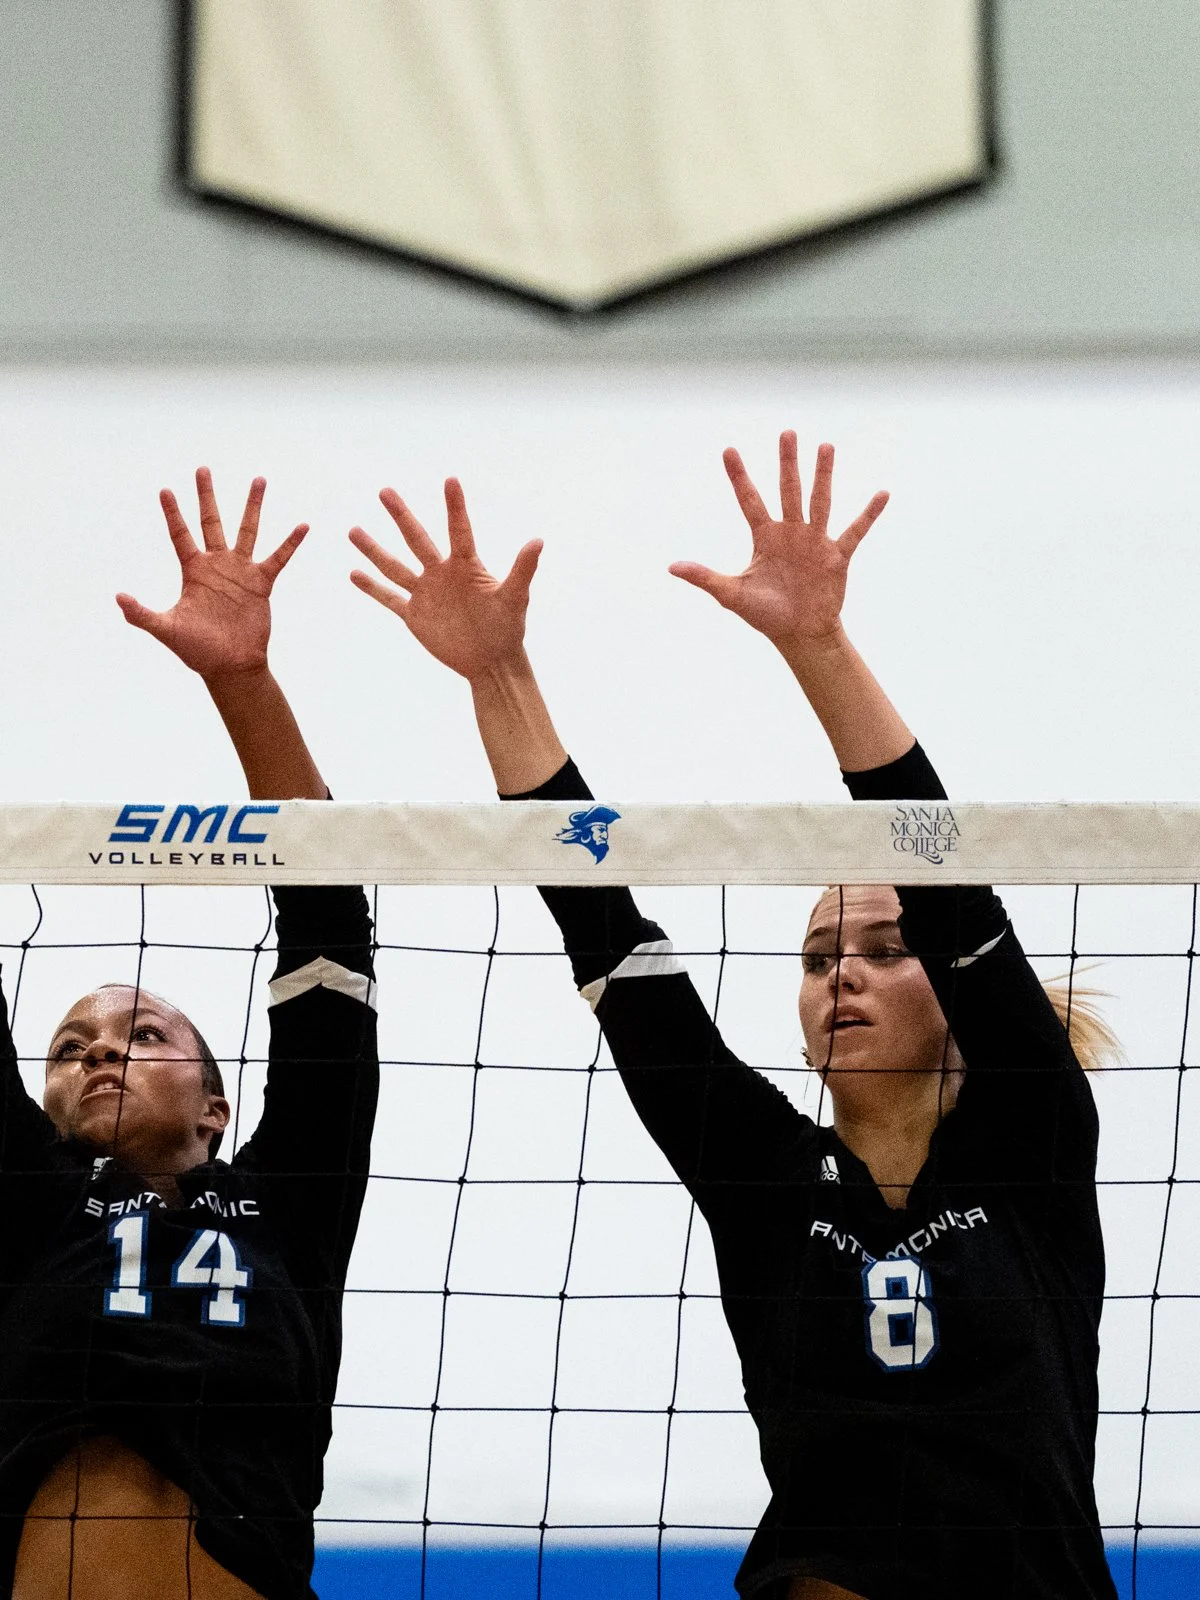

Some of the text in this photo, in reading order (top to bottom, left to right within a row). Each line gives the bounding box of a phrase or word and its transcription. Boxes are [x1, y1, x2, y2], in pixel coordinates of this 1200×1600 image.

[108, 804, 281, 843] SMC
[895, 805, 956, 821] SANTA
[890, 821, 961, 836] MONICA
[88, 852, 286, 866] VOLLEYBALL
[893, 836, 958, 865] COLLEGE
[84, 1191, 168, 1218] SANT
[103, 1211, 253, 1327] 14
[862, 1256, 940, 1372] 8
